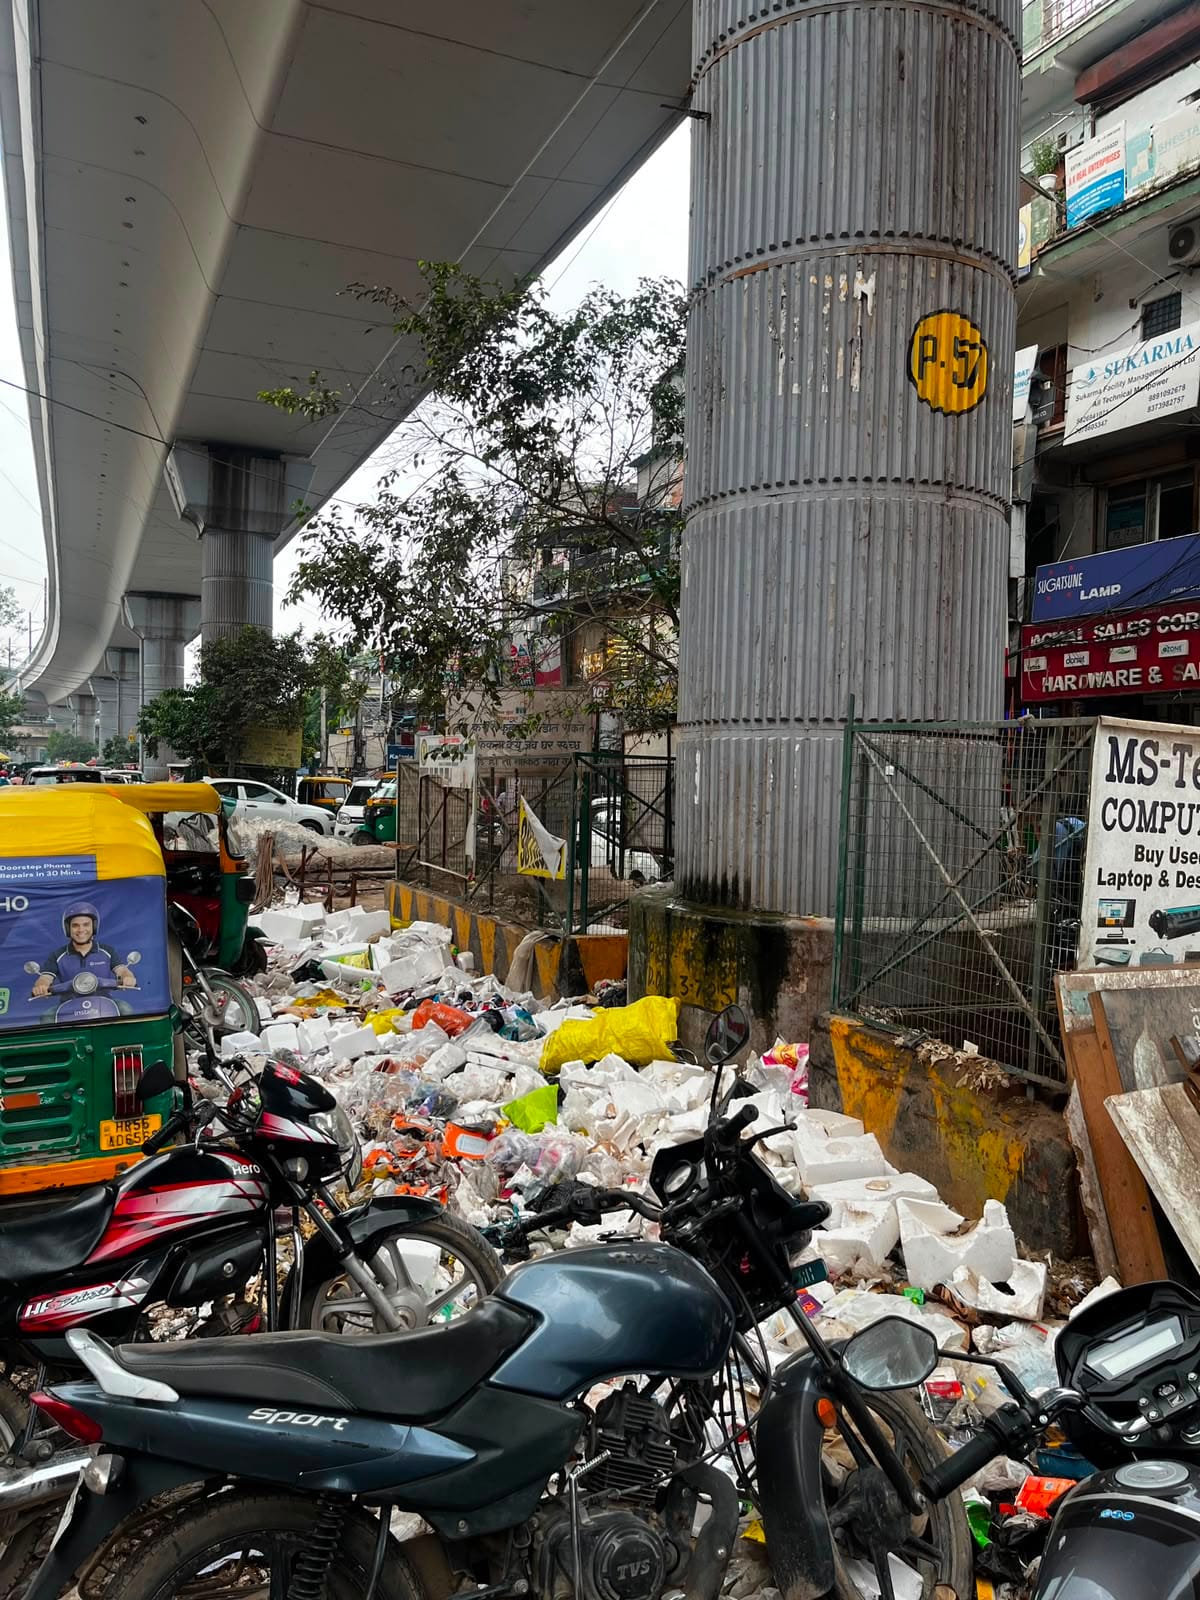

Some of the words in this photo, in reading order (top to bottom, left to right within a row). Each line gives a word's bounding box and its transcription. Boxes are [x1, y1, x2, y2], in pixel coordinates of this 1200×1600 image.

[1103, 333, 1194, 380] SUKARMA
[1075, 389, 1102, 402] Sukarma
[1102, 378, 1126, 392] Facility
[1128, 364, 1171, 383] Management
[1183, 354, 1196, 366] Ltd
[1102, 389, 1133, 404] Technical
[1037, 572, 1084, 595] SUGATSUNE
[1079, 584, 1121, 600] LAMP
[1042, 668, 1142, 693] HARDWARE
[1148, 666, 1163, 684] &
[1172, 662, 1200, 682] SA
[1101, 797, 1200, 836] COMPU
[1134, 844, 1164, 867] Buy
[1169, 846, 1200, 864] Use
[1097, 868, 1152, 891] Laptop
[1158, 870, 1169, 888] &
[107, 1130, 160, 1147] AD656
[232, 1163, 261, 1176] Hero
[25, 1299, 54, 1318] HF
[248, 1407, 349, 1431] Sport
[617, 1558, 650, 1580] TVS
